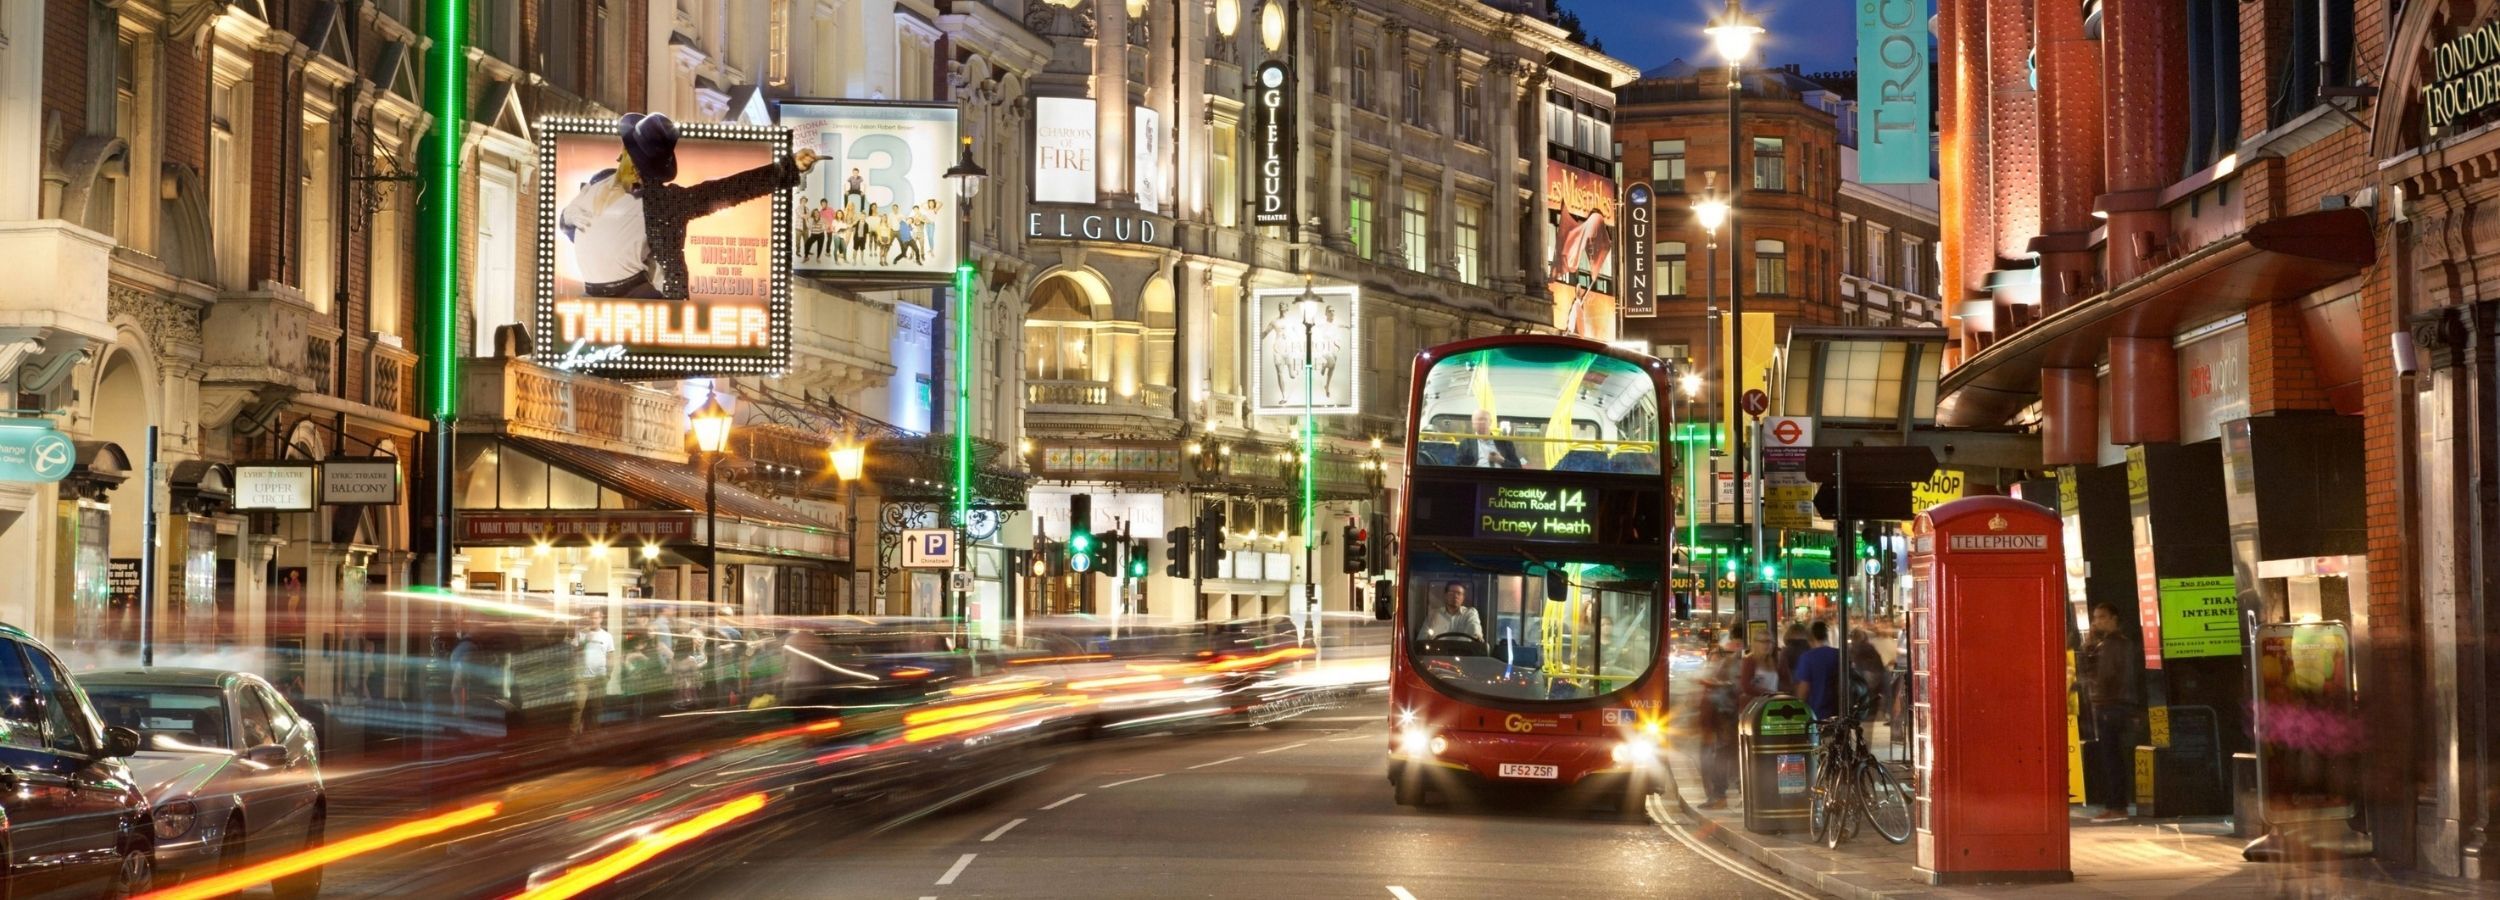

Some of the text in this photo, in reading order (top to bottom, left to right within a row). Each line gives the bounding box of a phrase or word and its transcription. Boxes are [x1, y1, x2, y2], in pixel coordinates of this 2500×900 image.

[2433, 21, 2500, 82] LONDON
[1039, 127, 1092, 139] CHARIOTS
[1039, 146, 1091, 172] FIRE
[1264, 90, 1281, 212] GIELGUD
[821, 132, 915, 214] 13
[701, 246, 758, 266] MICHAEL
[1633, 207, 1648, 305] QUEENS
[731, 267, 743, 276] THE
[690, 275, 767, 297] JACKSON 5
[555, 302, 771, 347] THRILLER
[1749, 393, 1763, 411] K
[244, 471, 266, 479] LYRIC
[254, 483, 292, 494] UPPER
[331, 484, 388, 494] BALCONY
[1498, 486, 1547, 501] Piccadilly
[252, 494, 294, 505] CIRCLE
[1488, 497, 1557, 511] Fulham Road
[1560, 488, 1587, 513] 14
[480, 521, 503, 535] WANT
[504, 521, 520, 535] YOU
[522, 521, 544, 535] BACK
[557, 521, 571, 535] I'LL
[573, 521, 583, 535] BE
[585, 521, 609, 535] THERE
[621, 521, 638, 535] CAN
[639, 521, 656, 535] YOU
[657, 521, 674, 535] FEEL
[675, 521, 683, 534] IT
[1482, 515, 1591, 537] Putney Heath
[929, 535, 943, 554] P
[1956, 535, 2043, 548] TELEPHONE
[2182, 607, 2239, 618] INTERNE
[1504, 713, 1533, 733] Go
[1503, 764, 1554, 777] LF52 ZSR
